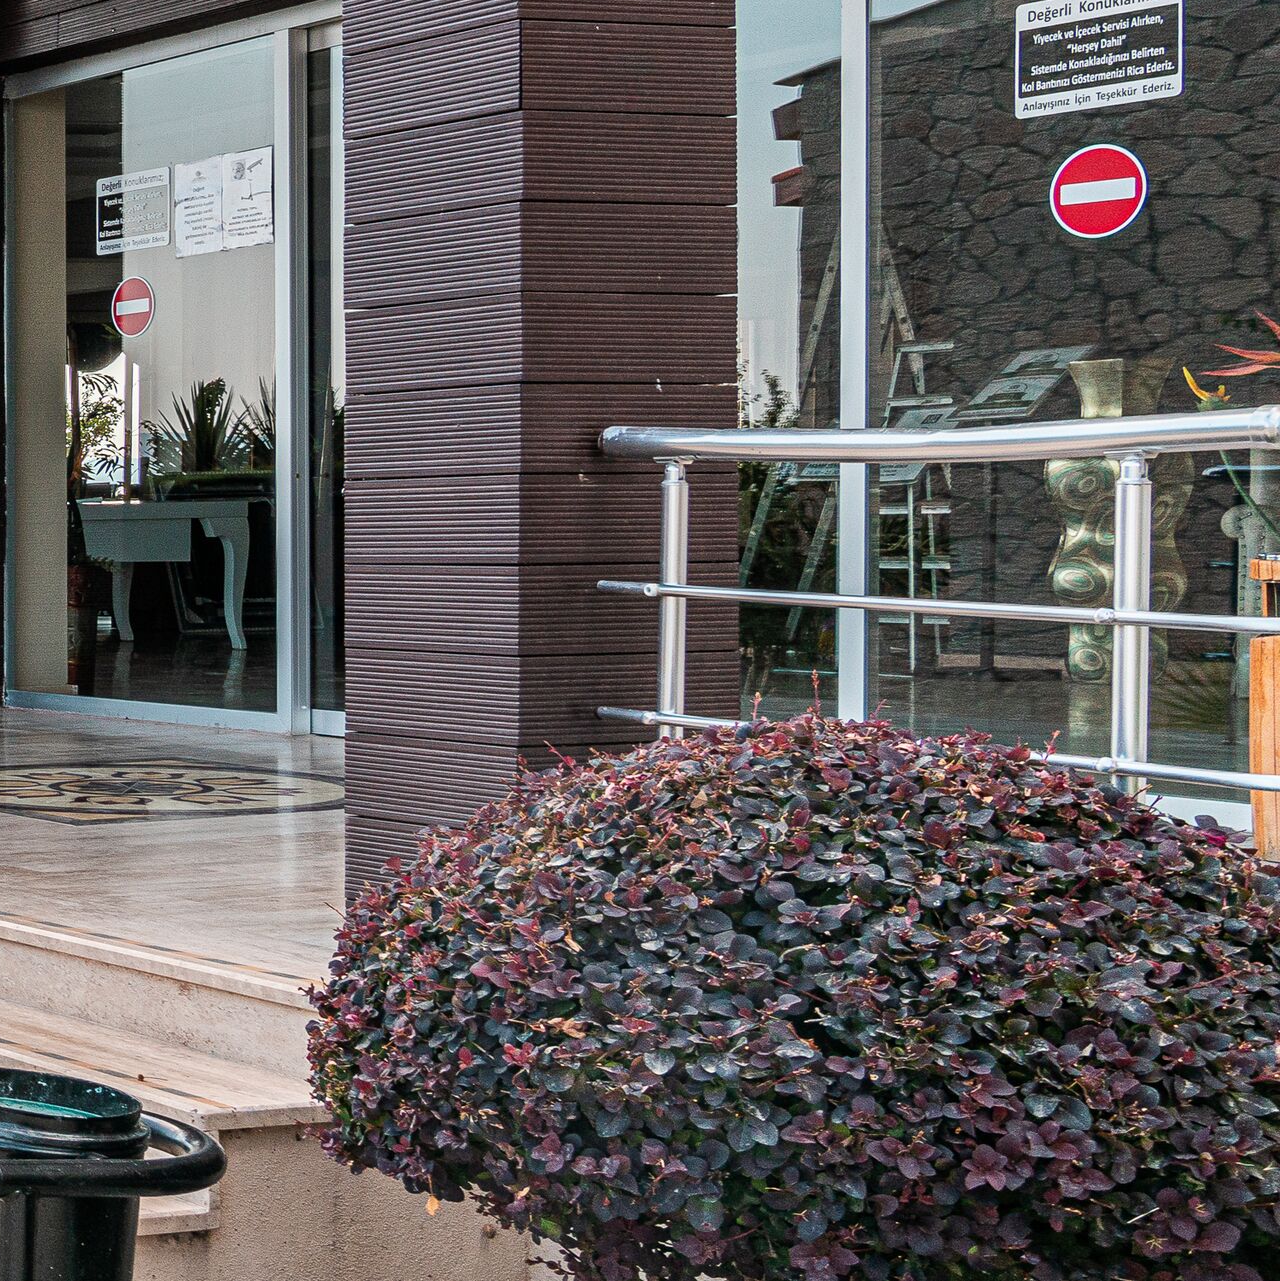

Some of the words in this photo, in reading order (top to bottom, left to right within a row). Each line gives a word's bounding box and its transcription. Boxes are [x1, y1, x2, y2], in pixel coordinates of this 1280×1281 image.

[1027, 3, 1072, 23] Değerli
[1032, 29, 1063, 46] Yiyecek
[1064, 30, 1074, 39] ve
[1075, 23, 1101, 39] İçecek
[1101, 18, 1130, 33] Servisi
[1130, 14, 1164, 28] Alırken,
[1021, 81, 1035, 93] Kol
[1071, 66, 1126, 85] Göstermenizi
[1126, 64, 1145, 76] Rica
[1146, 60, 1176, 74] Ederiz.
[1030, 60, 1068, 76] Sistemde
[1131, 46, 1165, 60] Belirten
[1022, 97, 1071, 112] Anlayışınız
[1074, 93, 1091, 106] İçin
[1095, 86, 1138, 102] Teşekkür
[1142, 81, 1175, 94] Ederiz.
